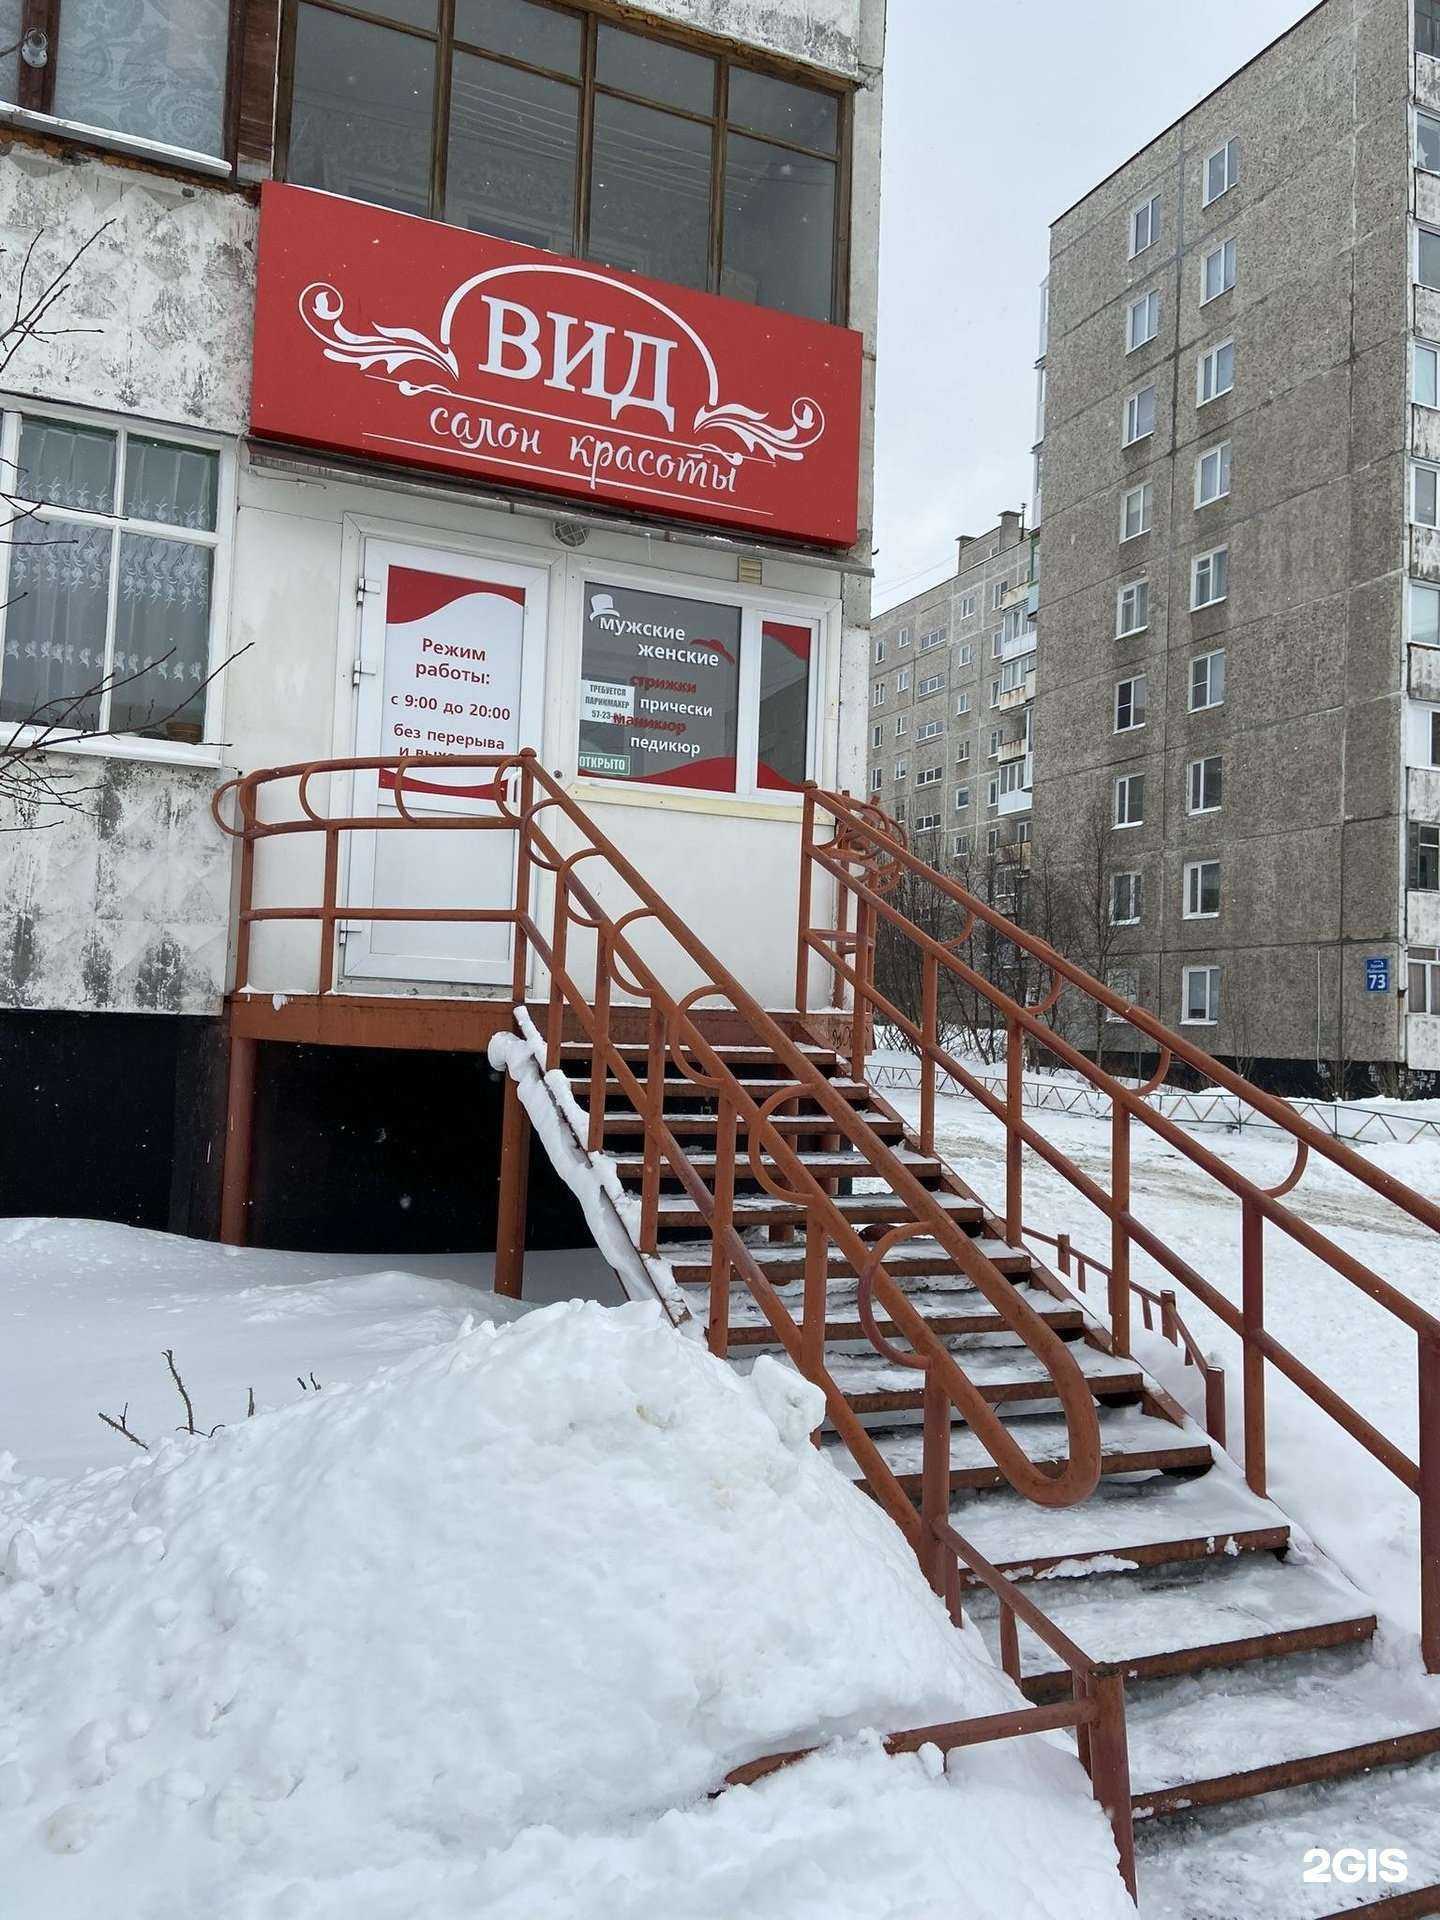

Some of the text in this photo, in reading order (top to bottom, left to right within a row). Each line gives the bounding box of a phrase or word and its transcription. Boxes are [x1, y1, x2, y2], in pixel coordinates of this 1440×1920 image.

[478, 294, 678, 433] ВИД
[430, 406, 737, 491] салон красоты
[599, 616, 686, 641] мужские
[422, 638, 486, 662] Режим
[638, 642, 719, 667] женские
[415, 663, 490, 685] работы:
[631, 675, 697, 694] стрижки
[585, 696, 630, 709] ПАРИКМАХЕР
[590, 685, 627, 697] ТРЕБУЕТСЯ
[391, 694, 511, 721] с 9:00 до 20:00
[640, 698, 713, 718] прически
[612, 712, 687, 735] маникюр
[393, 723, 505, 750] без перерыва
[630, 735, 701, 758] педикюр
[579, 755, 625, 771] ОТКРЫТО
[1368, 974, 1386, 989] 73
